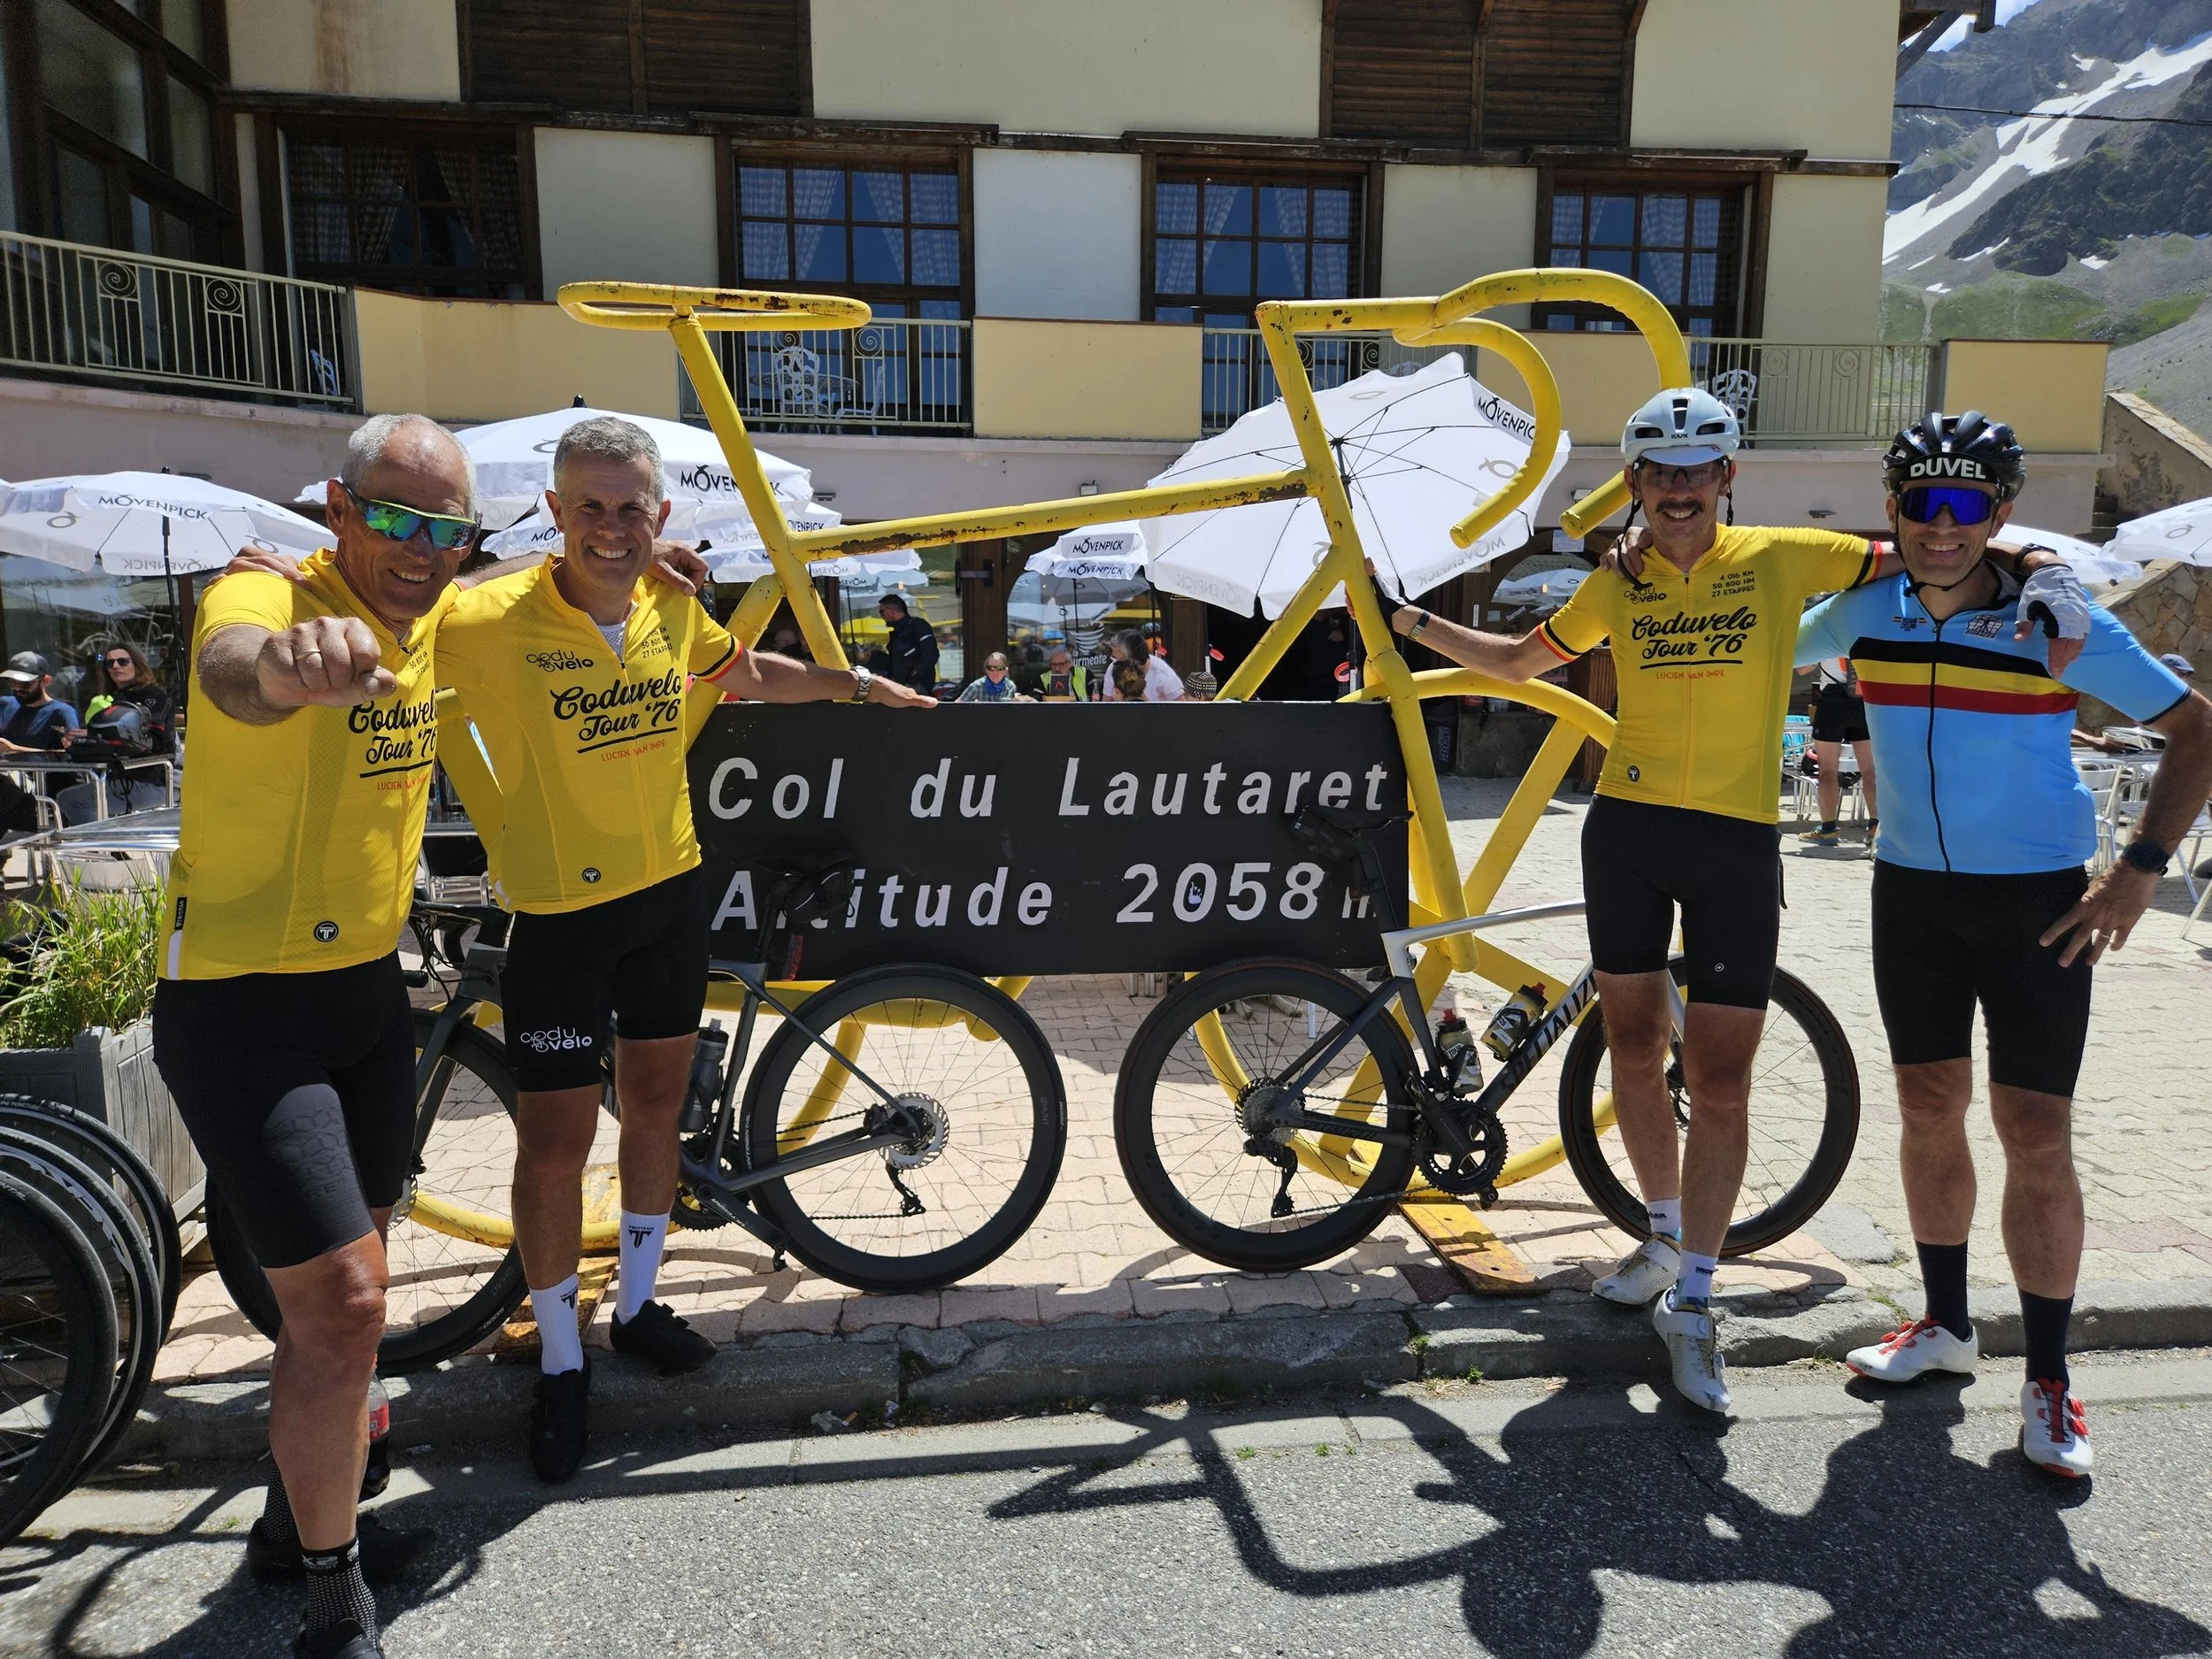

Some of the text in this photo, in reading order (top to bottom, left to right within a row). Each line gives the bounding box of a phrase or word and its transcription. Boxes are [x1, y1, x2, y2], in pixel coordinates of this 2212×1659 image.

[1479, 397, 1535, 441] MÖVENPIC
[1910, 457, 1986, 479] DUVEL
[1724, 585, 1755, 596] ETAPPES
[1725, 579, 1740, 588] 800
[1632, 605, 1757, 641] Coduvelo
[641, 649, 649, 659] 27
[1642, 639, 1698, 660] Tour
[1656, 672, 1685, 680] LUCIEN
[1706, 669, 1725, 678] IMPE
[549, 667, 682, 720] Coduvelo
[579, 712, 641, 741] Tour
[365, 735, 414, 765] Tour
[602, 750, 631, 762] LUCIEN
[650, 739, 666, 751] IMPE
[377, 780, 403, 791] LUCIEN
[709, 757, 1387, 819] Col du Lautaret
[710, 866, 1053, 930] Aitude
[1116, 862, 1325, 923] 2058
